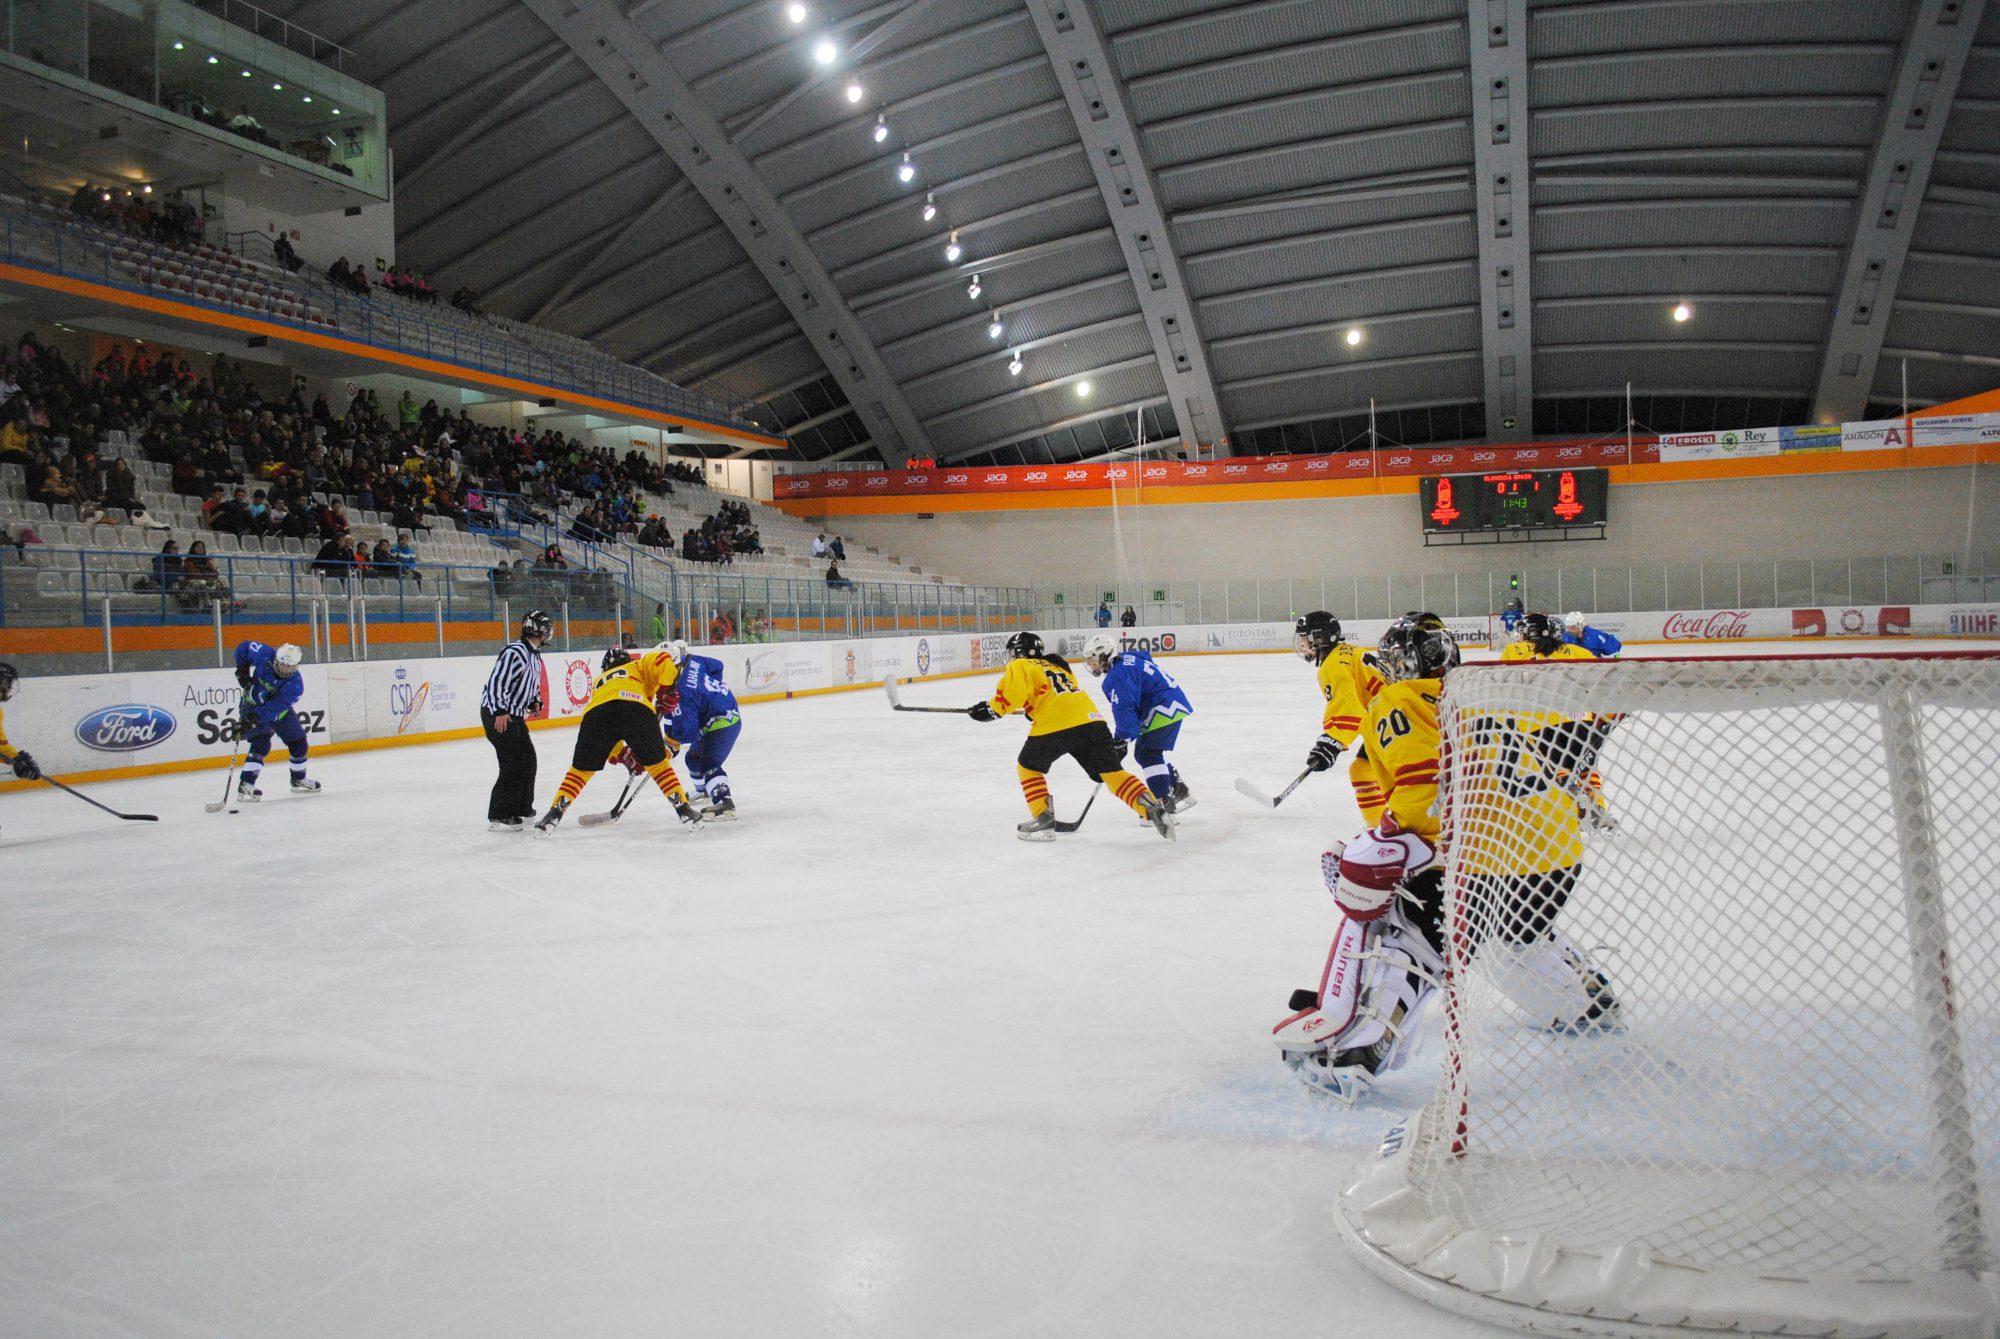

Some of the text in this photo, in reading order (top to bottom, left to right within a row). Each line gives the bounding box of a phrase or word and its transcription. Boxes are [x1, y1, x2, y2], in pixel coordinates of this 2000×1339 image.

[1677, 435, 1714, 446] EROSKI
[1744, 430, 1767, 442] Rey
[1662, 611, 1751, 639] Coca-Cola
[184, 684, 241, 706] Autom
[96, 712, 157, 745] Ford
[197, 708, 326, 745] Sáez
[1376, 708, 1412, 749] 20
